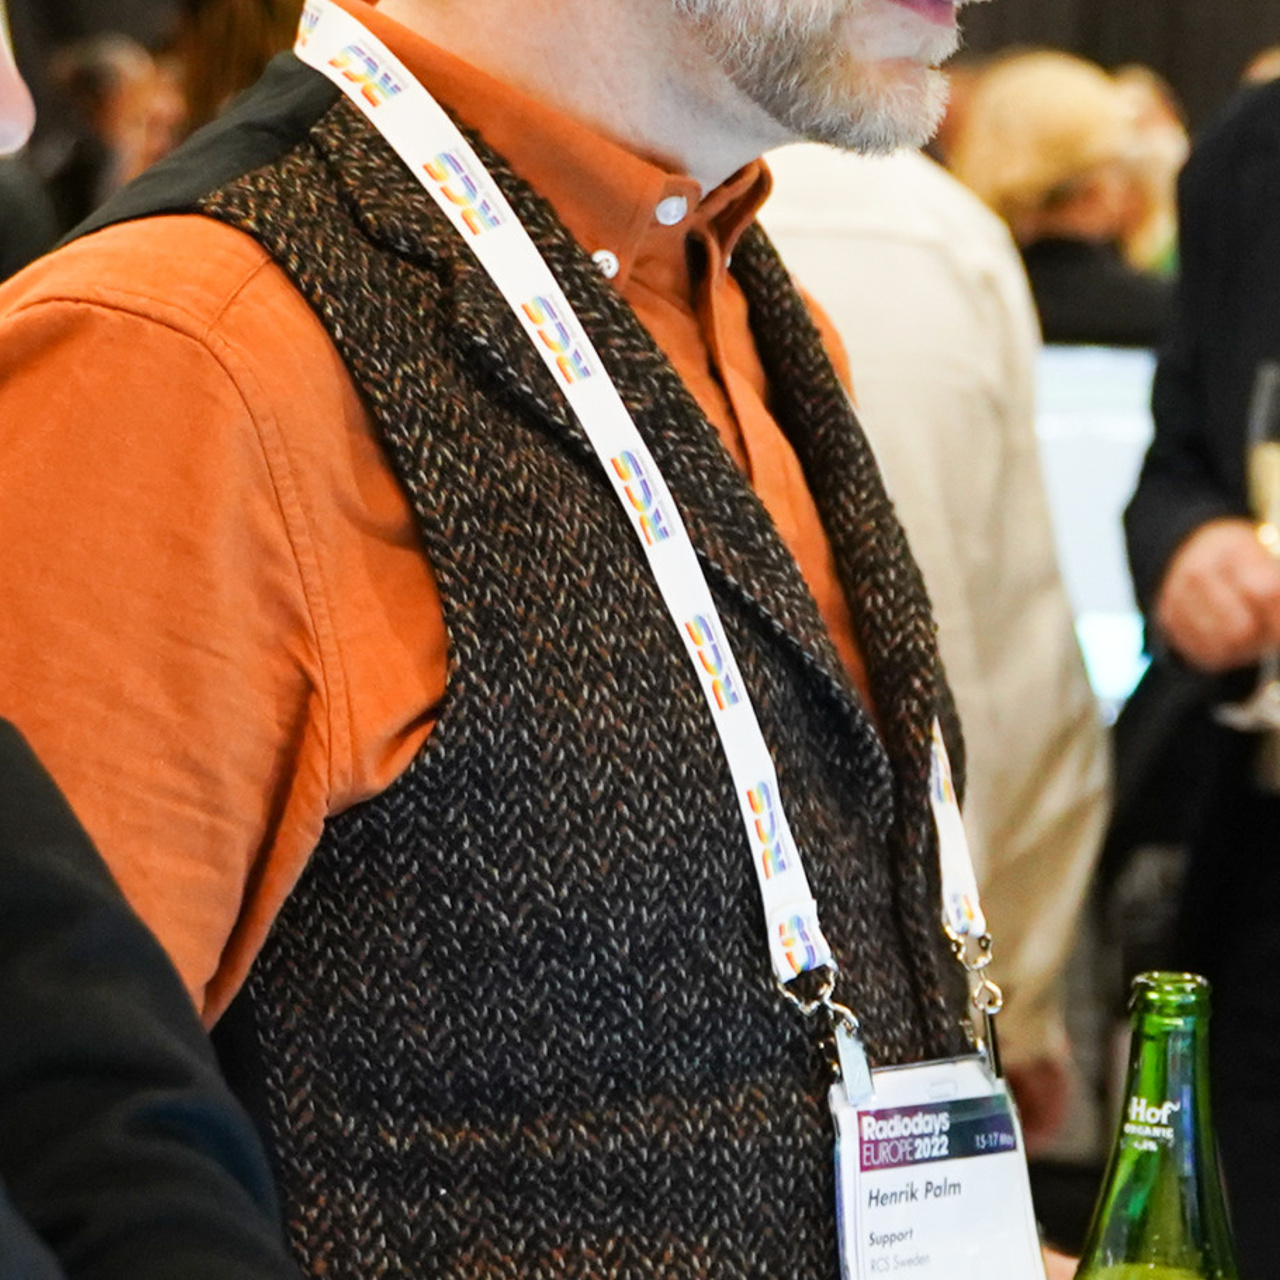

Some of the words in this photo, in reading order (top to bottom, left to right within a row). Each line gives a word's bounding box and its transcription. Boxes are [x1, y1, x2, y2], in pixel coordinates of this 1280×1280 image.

[422, 151, 501, 236] RCS
[520, 295, 592, 384] RCS
[610, 450, 670, 546] RCS
[685, 614, 740, 711] RCS
[747, 781, 787, 880] RCS
[862, 1111, 950, 1140] Radiodays
[1130, 1096, 1181, 1125] Hof
[863, 1140, 914, 1167] EUROPE
[914, 1136, 950, 1159] 2022
[868, 1182, 918, 1208] Henrik
[924, 1177, 962, 1200] Palm
[869, 1227, 913, 1247] Support
[893, 1252, 930, 1270] Sweden
